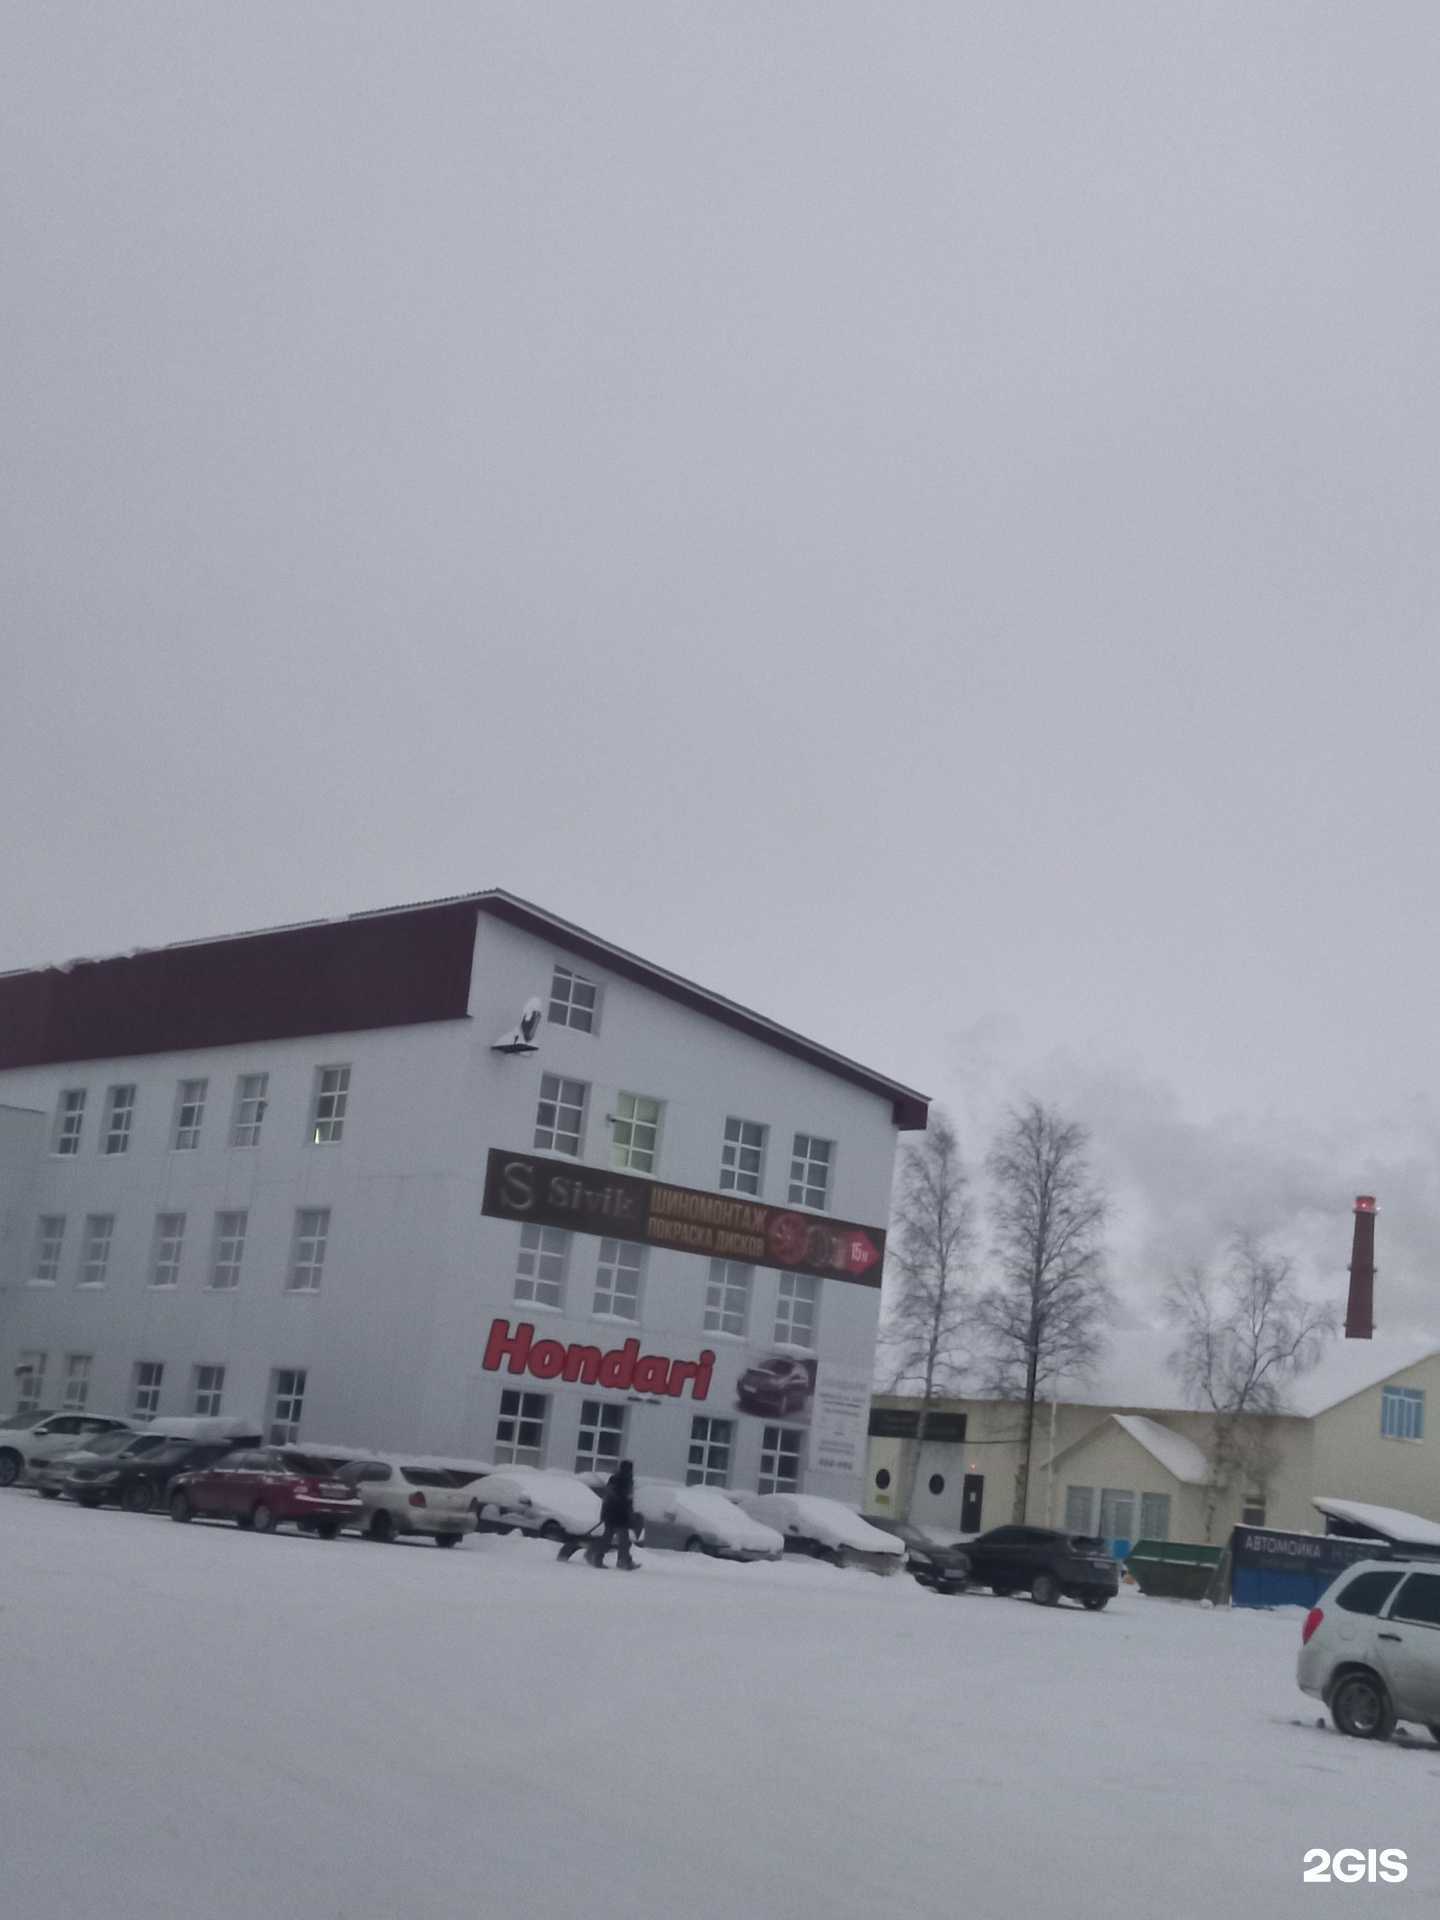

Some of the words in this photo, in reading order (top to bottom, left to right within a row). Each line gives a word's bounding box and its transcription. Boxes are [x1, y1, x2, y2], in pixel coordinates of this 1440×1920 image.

[649, 1187, 768, 1233] ШИНОМОНТАЖ
[647, 1216, 712, 1247] ПОКРАСКА
[715, 1230, 765, 1257] ДИСКОВ
[482, 1318, 716, 1400] Hondari
[1245, 1536, 1320, 1558] АВТОМОЙКА
